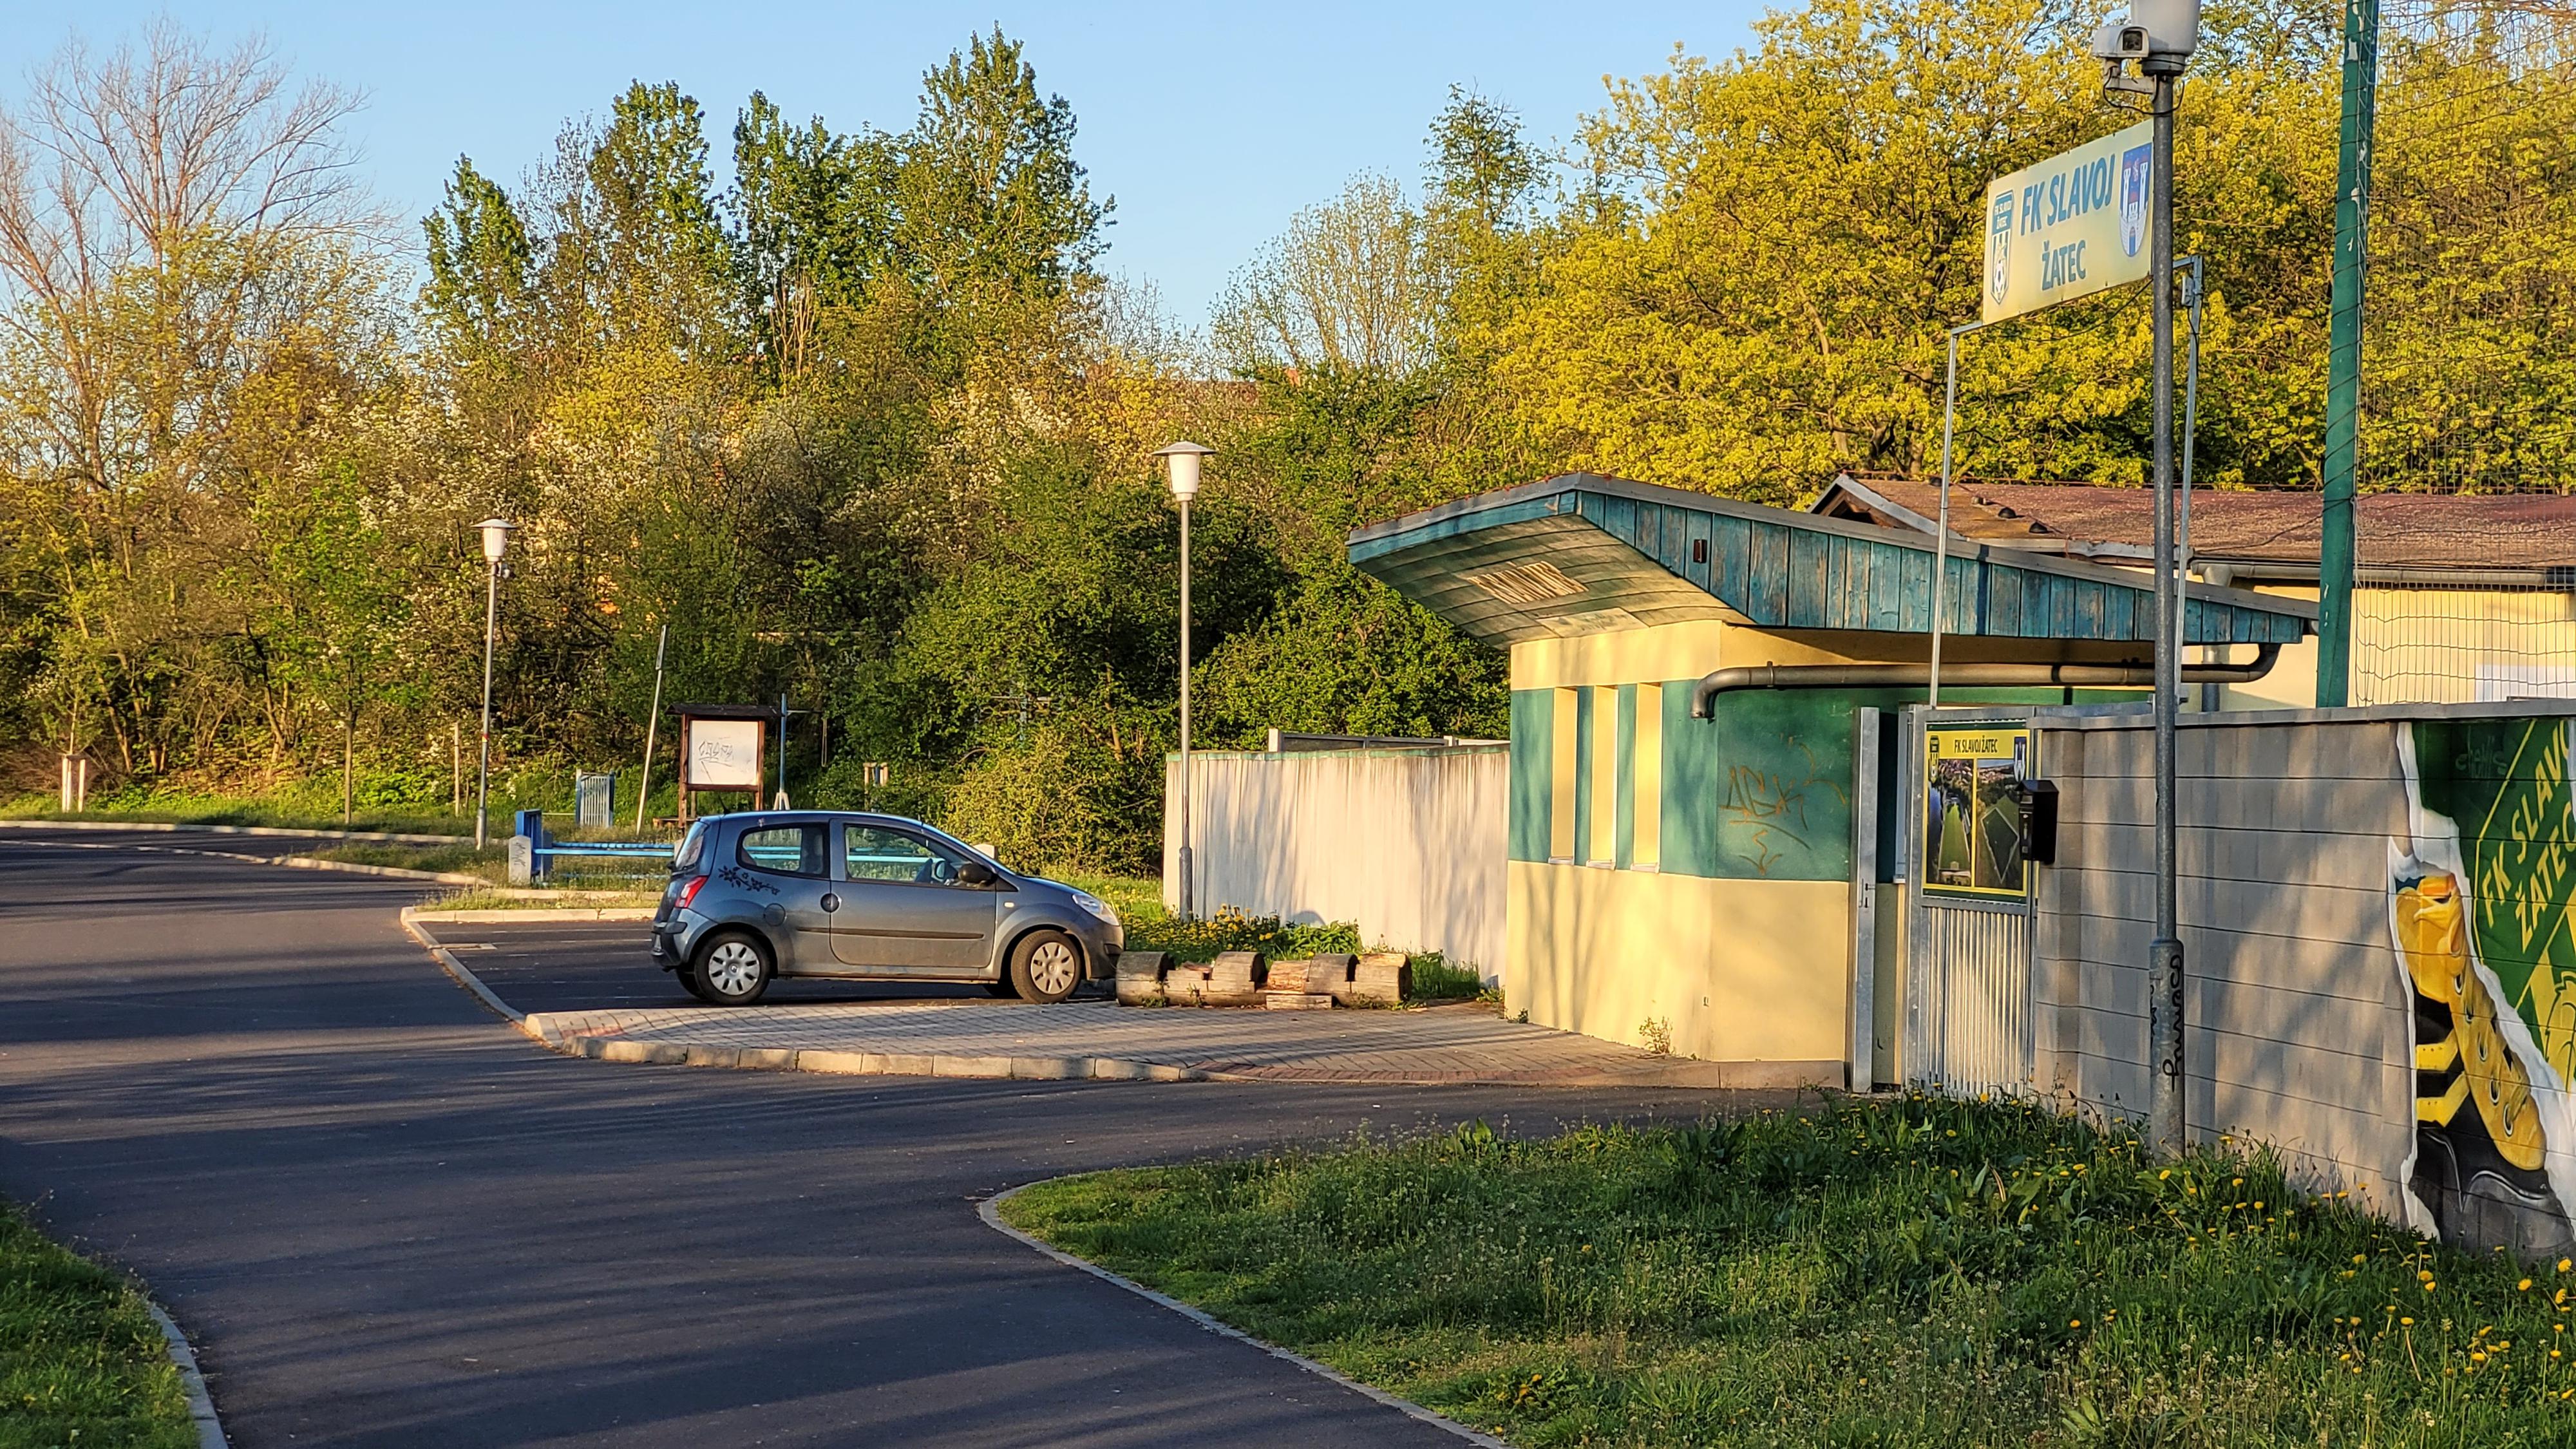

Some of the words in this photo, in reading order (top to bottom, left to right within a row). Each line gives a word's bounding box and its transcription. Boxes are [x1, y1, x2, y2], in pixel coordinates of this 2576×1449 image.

[2020, 181, 2045, 236] FK
[2047, 153, 2116, 227] SLAVOJ
[2041, 239, 2087, 291] ŽATEC
[1955, 739, 1962, 753] FK
[1962, 738, 1981, 753] SLAVOJ
[1981, 735, 1998, 753] ŽATEC
[2482, 840, 2512, 929] FK
[2514, 800, 2576, 954] ŽATEC
